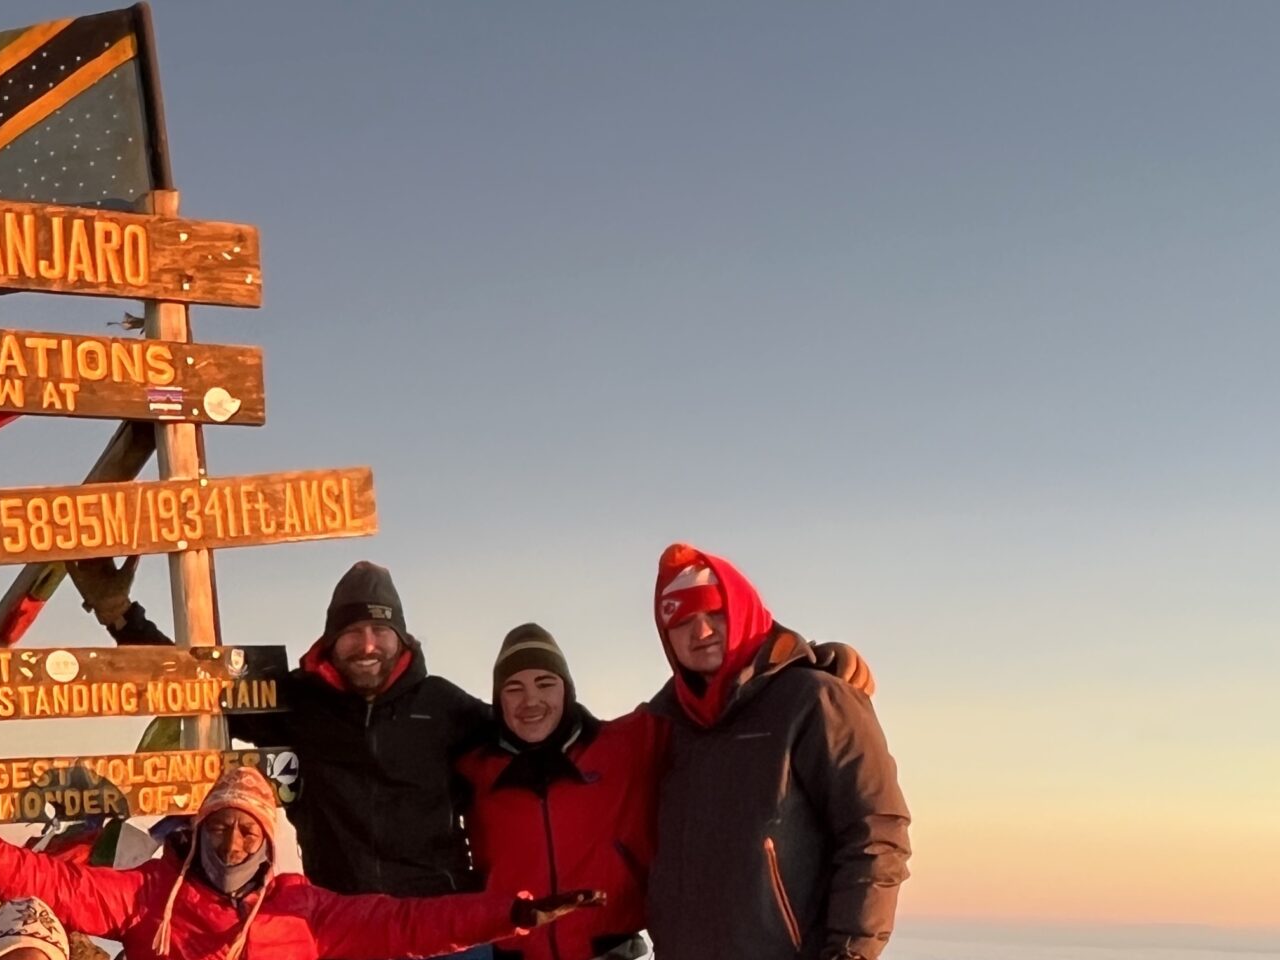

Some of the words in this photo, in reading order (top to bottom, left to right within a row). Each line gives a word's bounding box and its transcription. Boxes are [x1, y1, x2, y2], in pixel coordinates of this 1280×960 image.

[42, 382, 80, 411] AT
[147, 679, 277, 713] MOUNTAIN
[138, 785, 177, 815] OF
